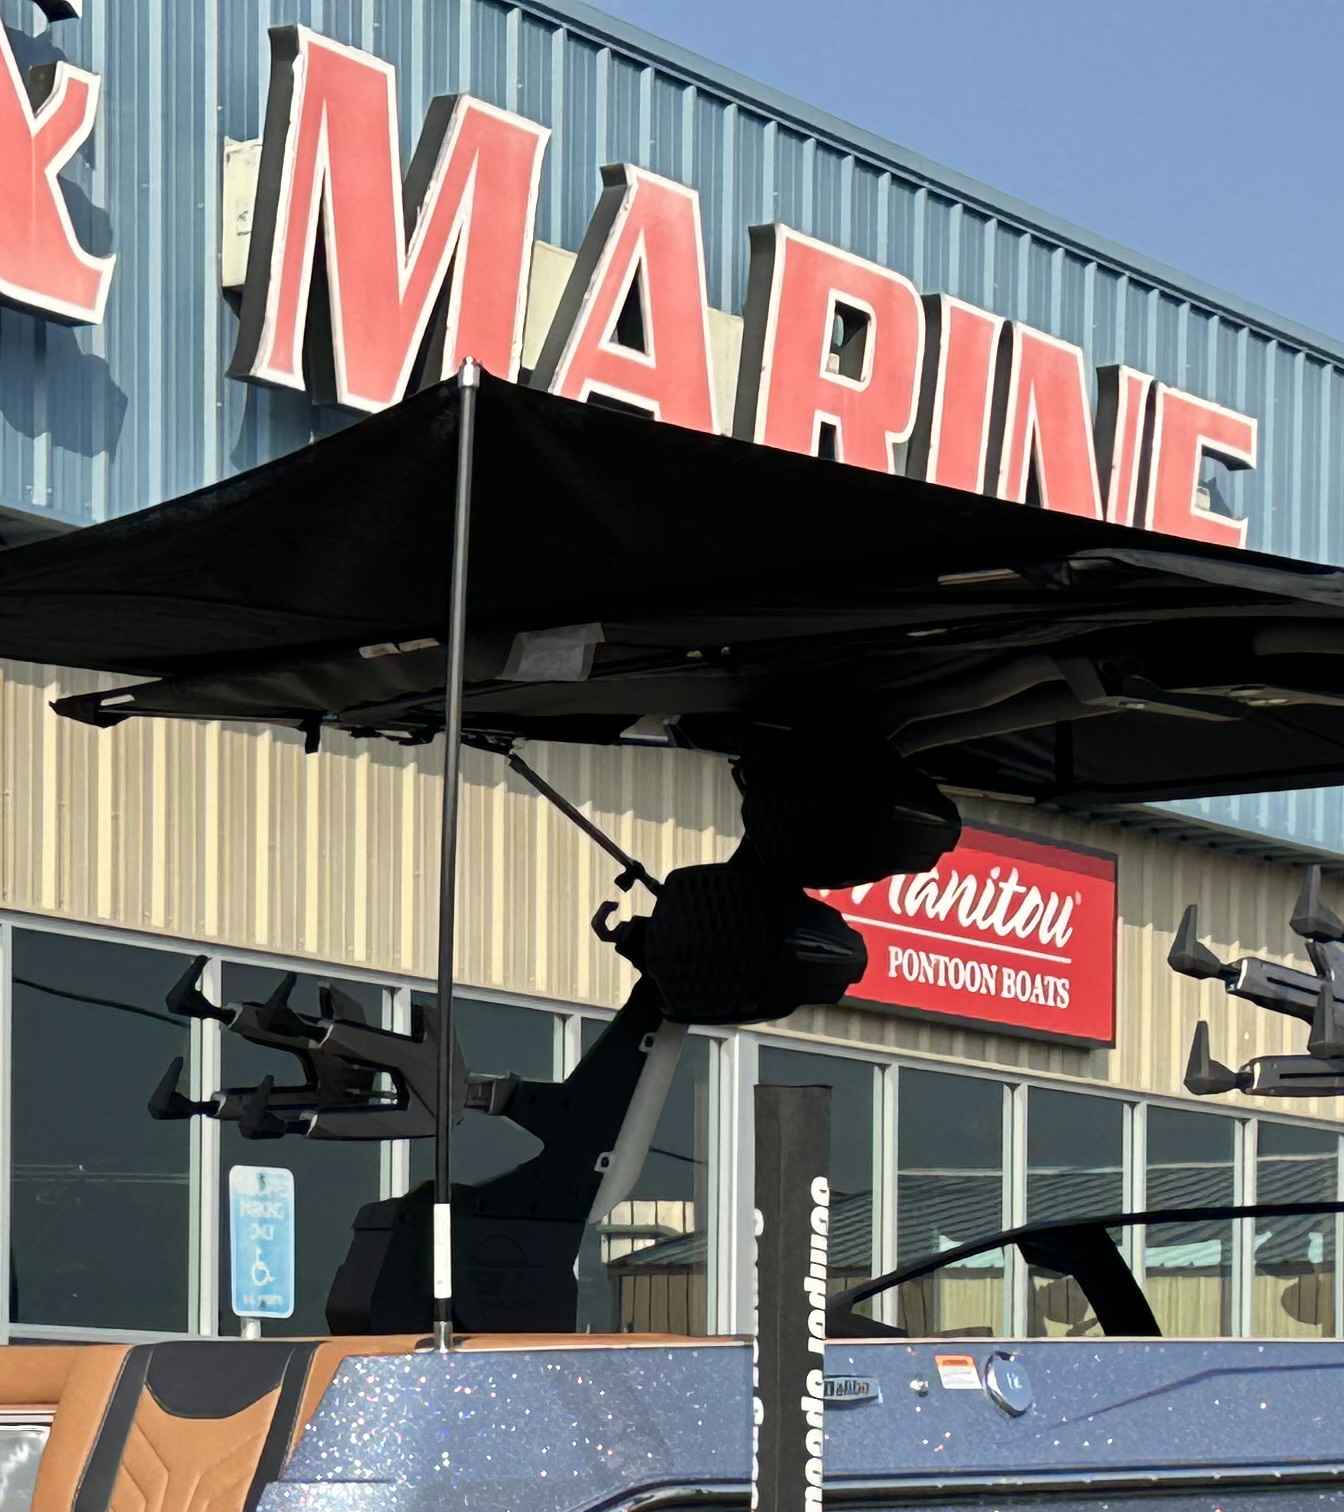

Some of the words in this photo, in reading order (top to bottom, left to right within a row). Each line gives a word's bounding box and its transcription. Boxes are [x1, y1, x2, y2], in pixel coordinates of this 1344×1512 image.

[228, 24, 1258, 548] MARINE
[846, 866, 1074, 948] anitou
[887, 945, 998, 995] PONTOON
[1001, 968, 1071, 1009] BOATS
